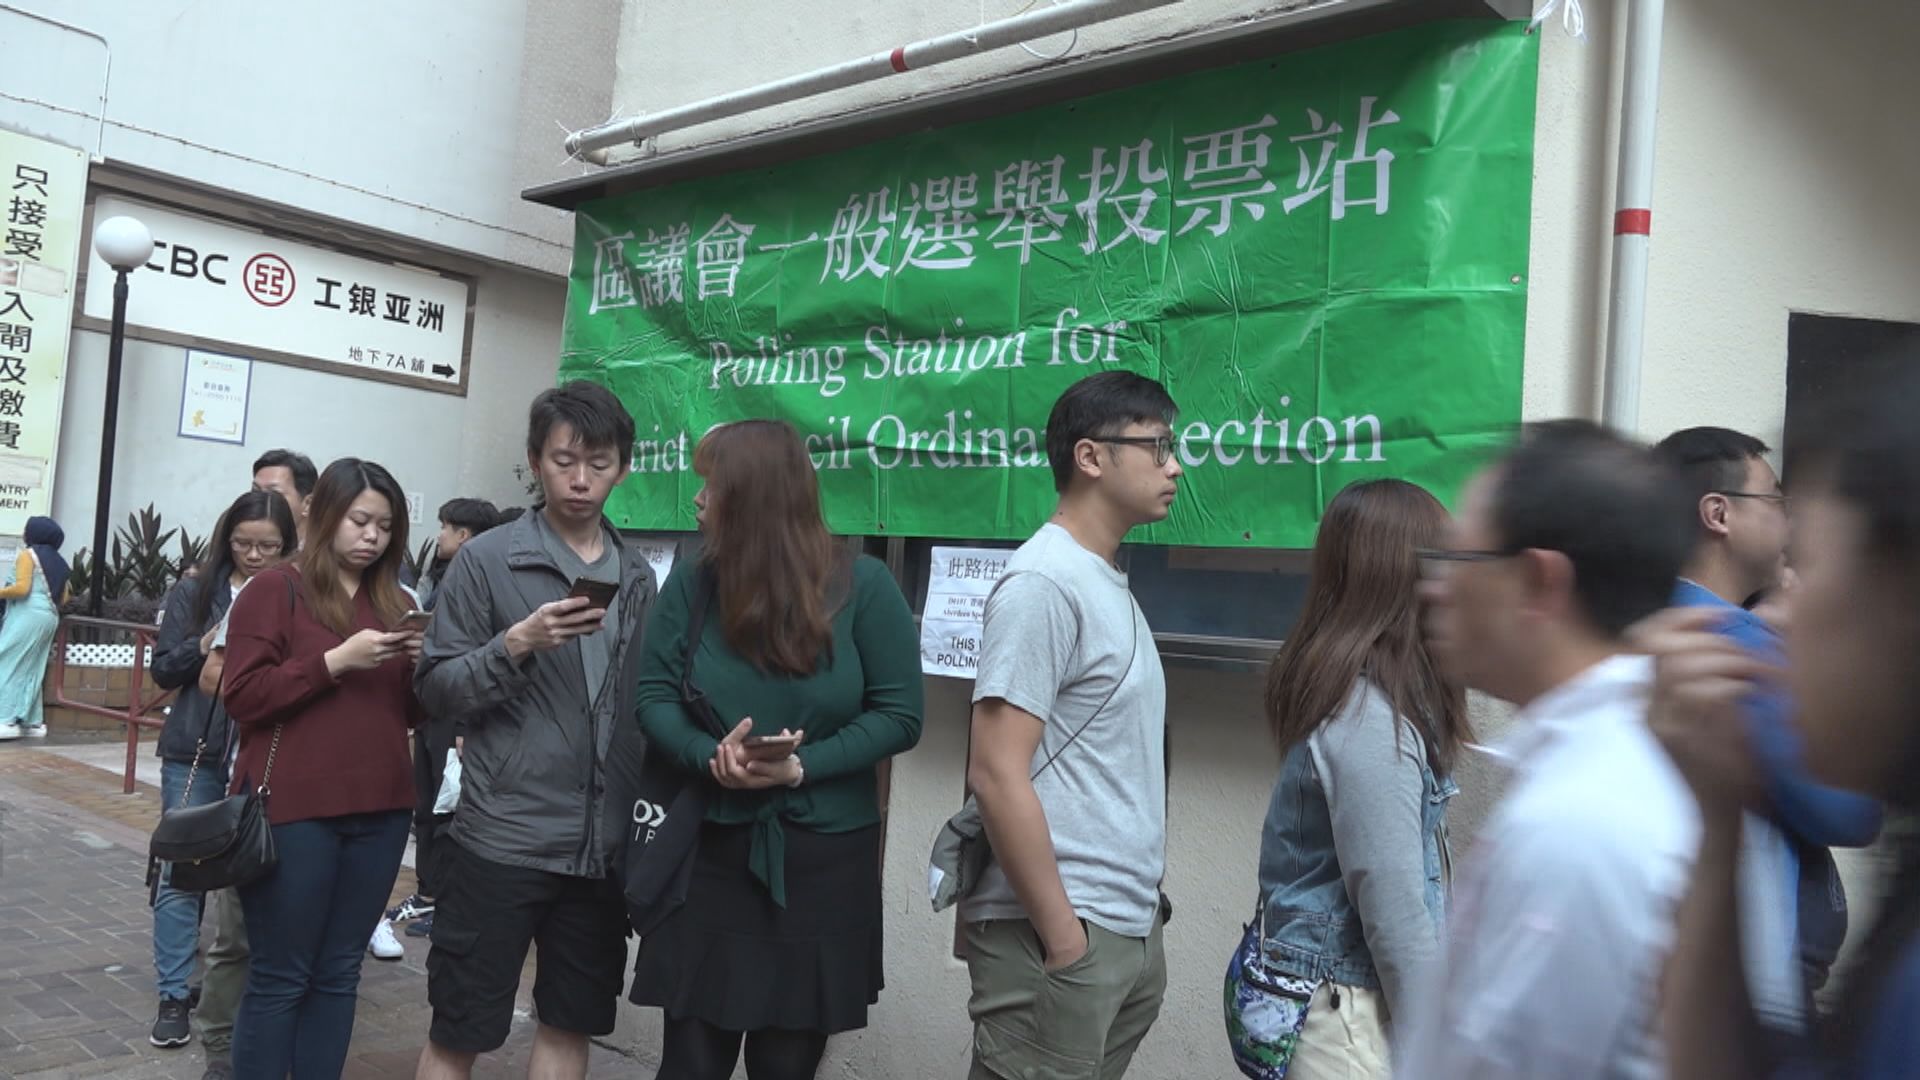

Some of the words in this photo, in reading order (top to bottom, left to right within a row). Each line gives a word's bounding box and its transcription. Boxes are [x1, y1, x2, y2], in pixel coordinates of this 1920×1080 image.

[4, 164, 48, 262] 只接受
[588, 95, 1401, 315] 區議會一般選舉投票站
[145, 239, 229, 285] CBC
[314, 276, 445, 333] 工银亚洲
[708, 334, 847, 397] Polling
[862, 316, 1026, 383] Station
[1046, 307, 1129, 367] for
[630, 423, 689, 473] trict
[865, 409, 1050, 469] Ordina
[1179, 396, 1388, 467] ection
[0, 484, 31, 496] NTRY
[950, 635, 976, 651] THIS
